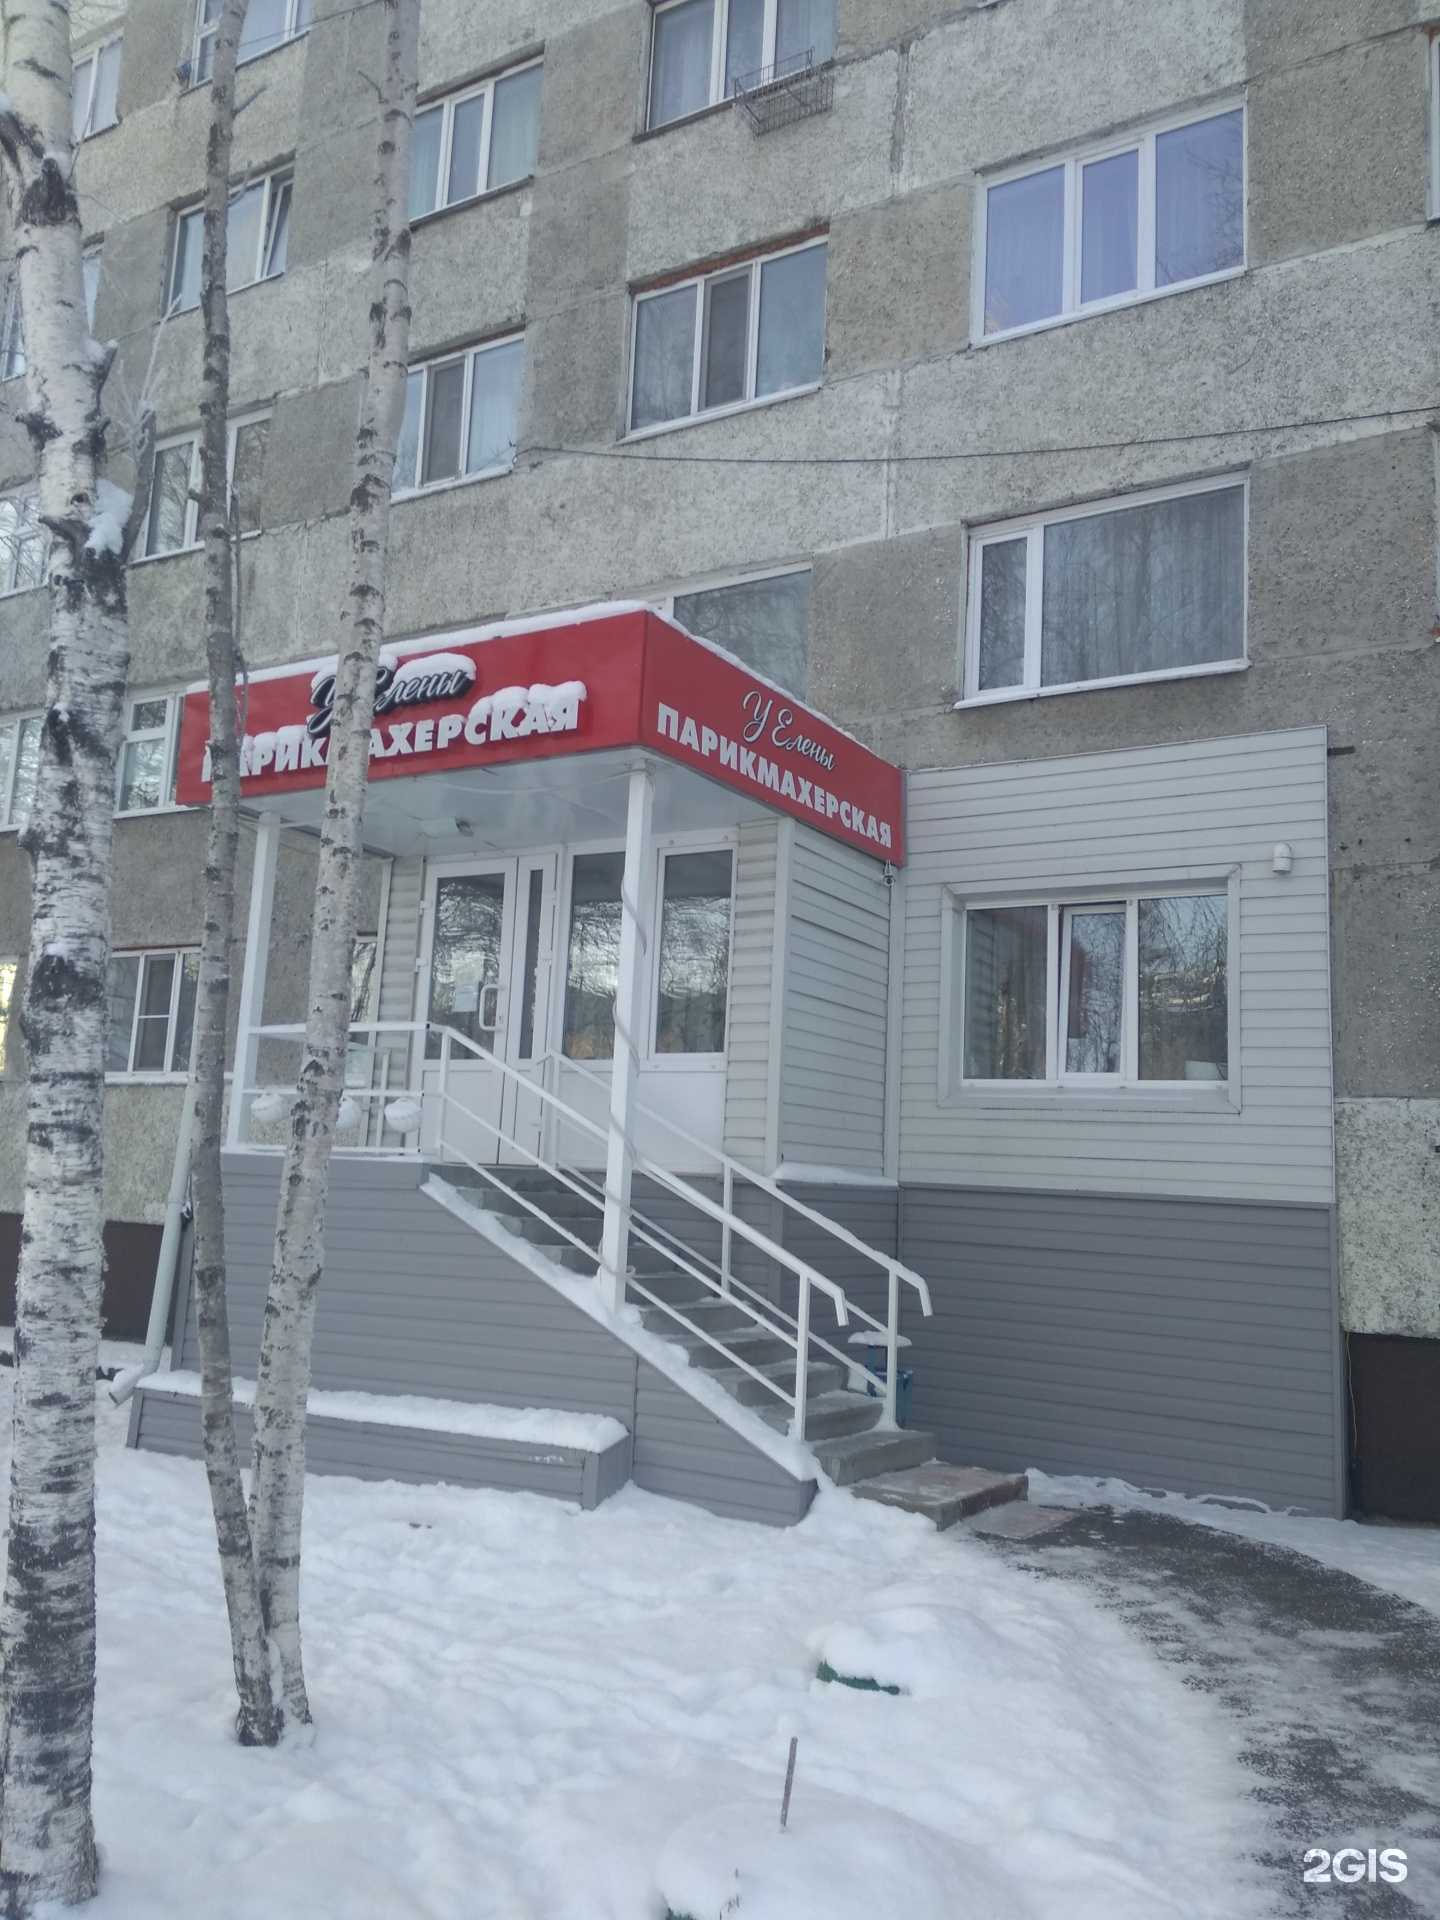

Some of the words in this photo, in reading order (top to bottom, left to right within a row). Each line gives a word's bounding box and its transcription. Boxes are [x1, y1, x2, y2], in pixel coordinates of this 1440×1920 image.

[656, 701, 893, 849] ПАРИКМАХЕРСКАЯ
[743, 690, 773, 743] У
[771, 708, 836, 771] Елены
